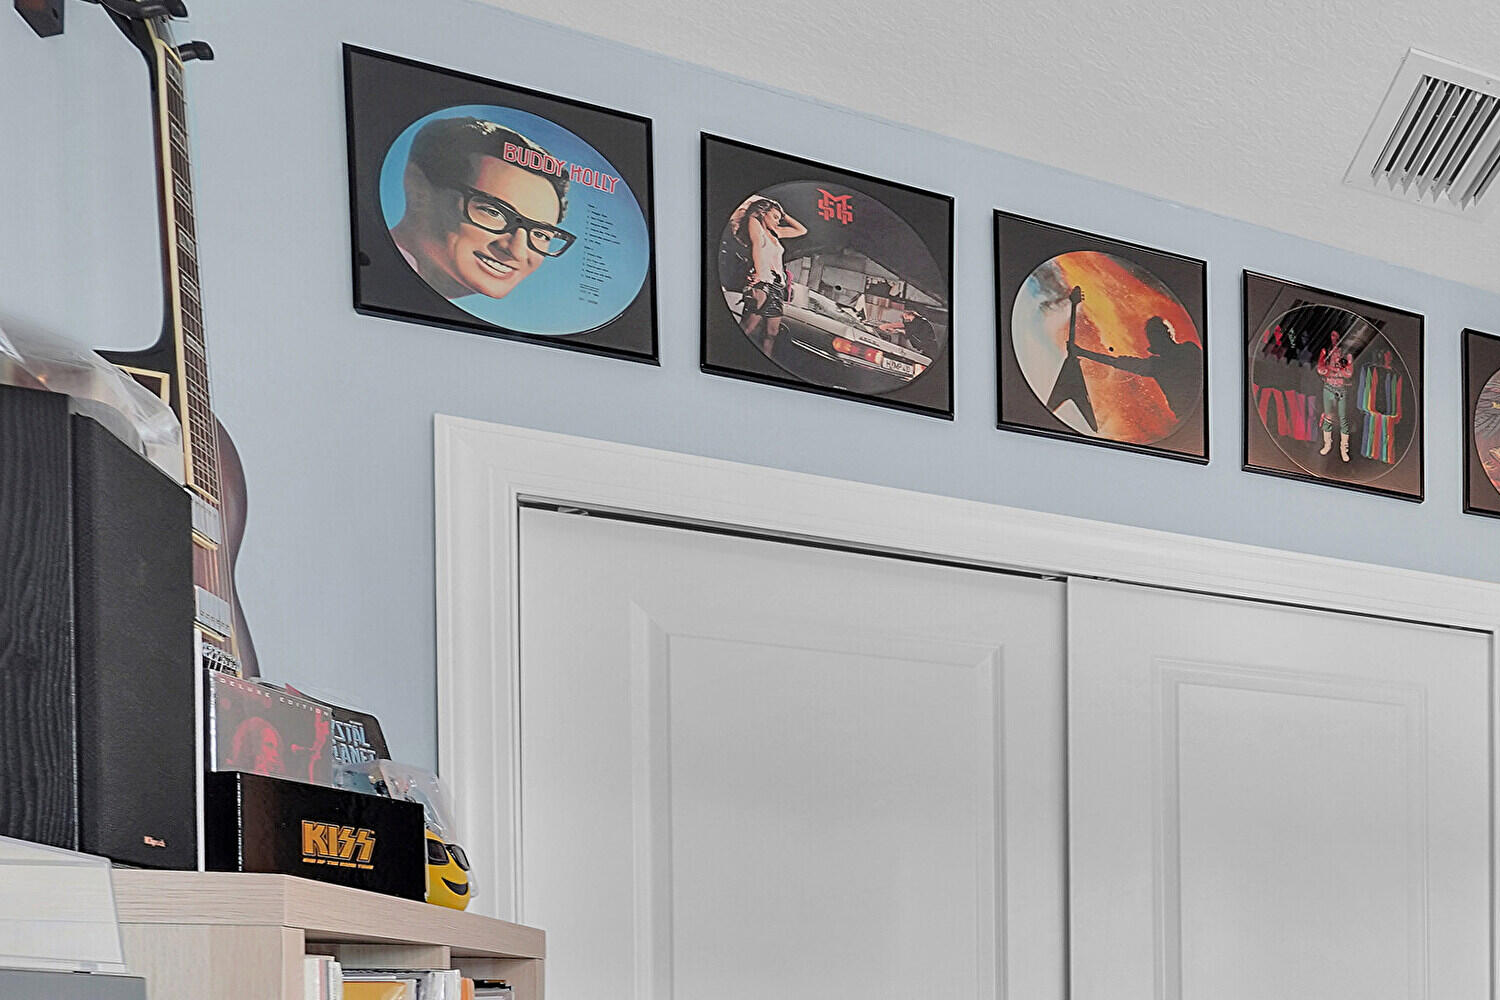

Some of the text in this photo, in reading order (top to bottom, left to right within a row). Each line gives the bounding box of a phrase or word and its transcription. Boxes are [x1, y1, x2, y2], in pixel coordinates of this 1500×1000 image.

[503, 141, 620, 194] BUDDY HOLLY
[279, 696, 330, 717] EDITION
[331, 719, 371, 748] STAL
[301, 820, 376, 863] KISS
